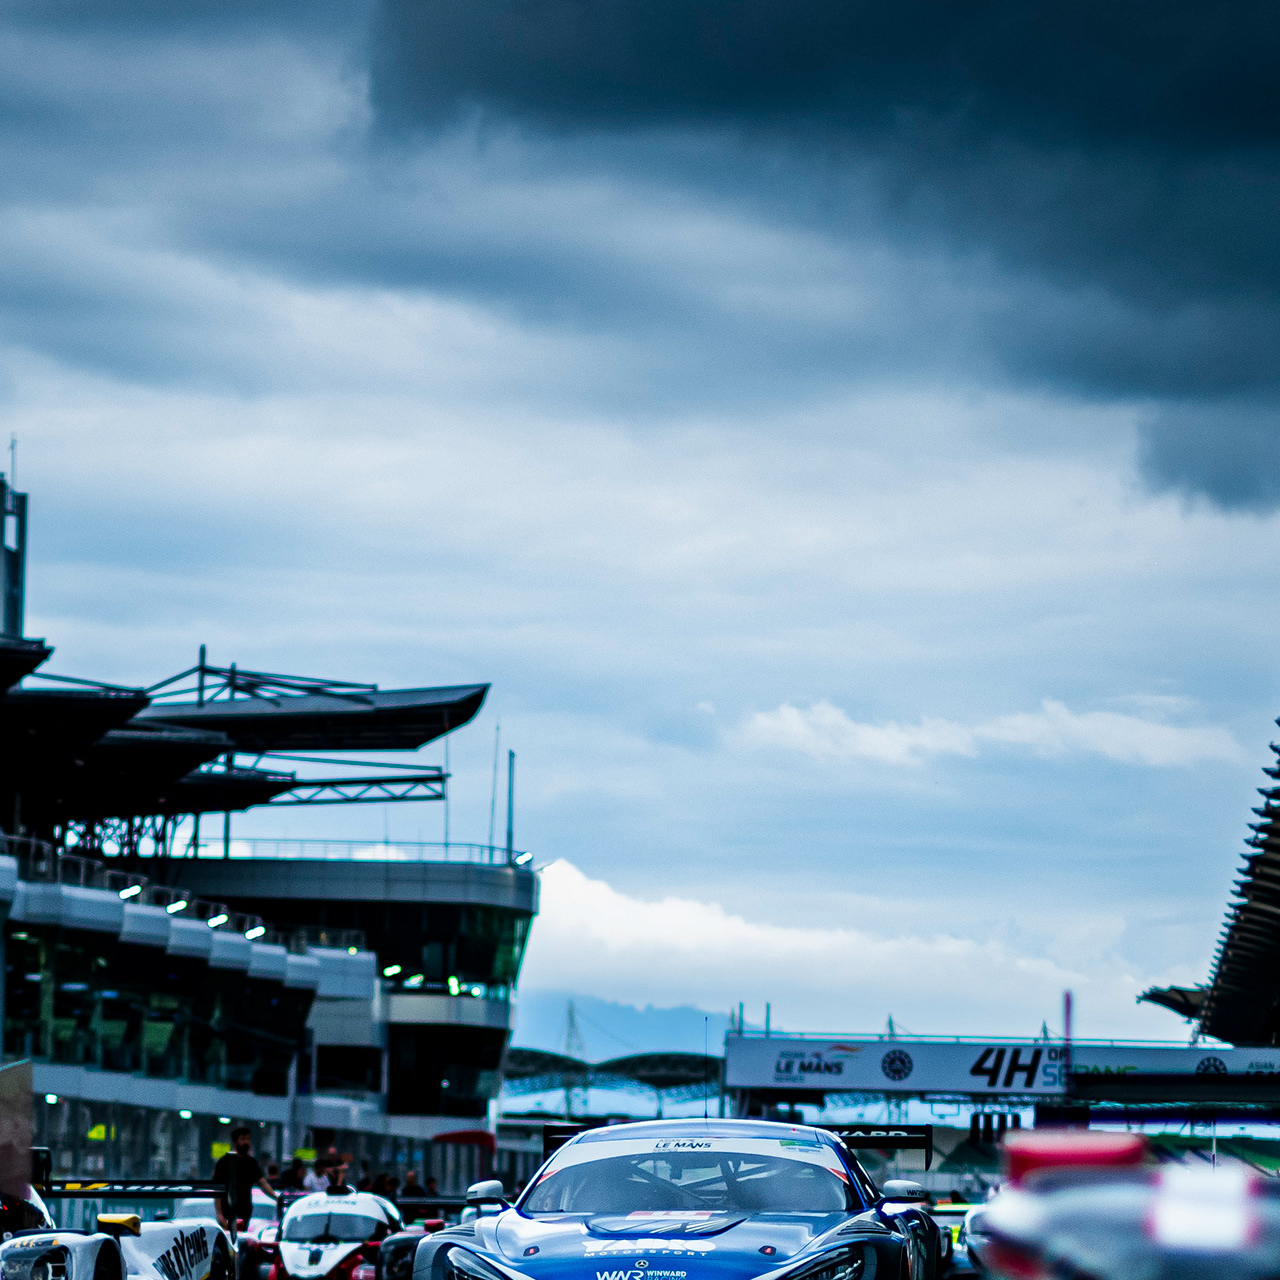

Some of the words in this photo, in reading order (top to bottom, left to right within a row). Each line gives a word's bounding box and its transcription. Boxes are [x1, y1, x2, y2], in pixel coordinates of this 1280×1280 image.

[775, 1060, 795, 1074] LE
[798, 1060, 844, 1075] MANS
[970, 1047, 1044, 1088] 4H
[584, 1249, 708, 1258] MOTORSPORT
